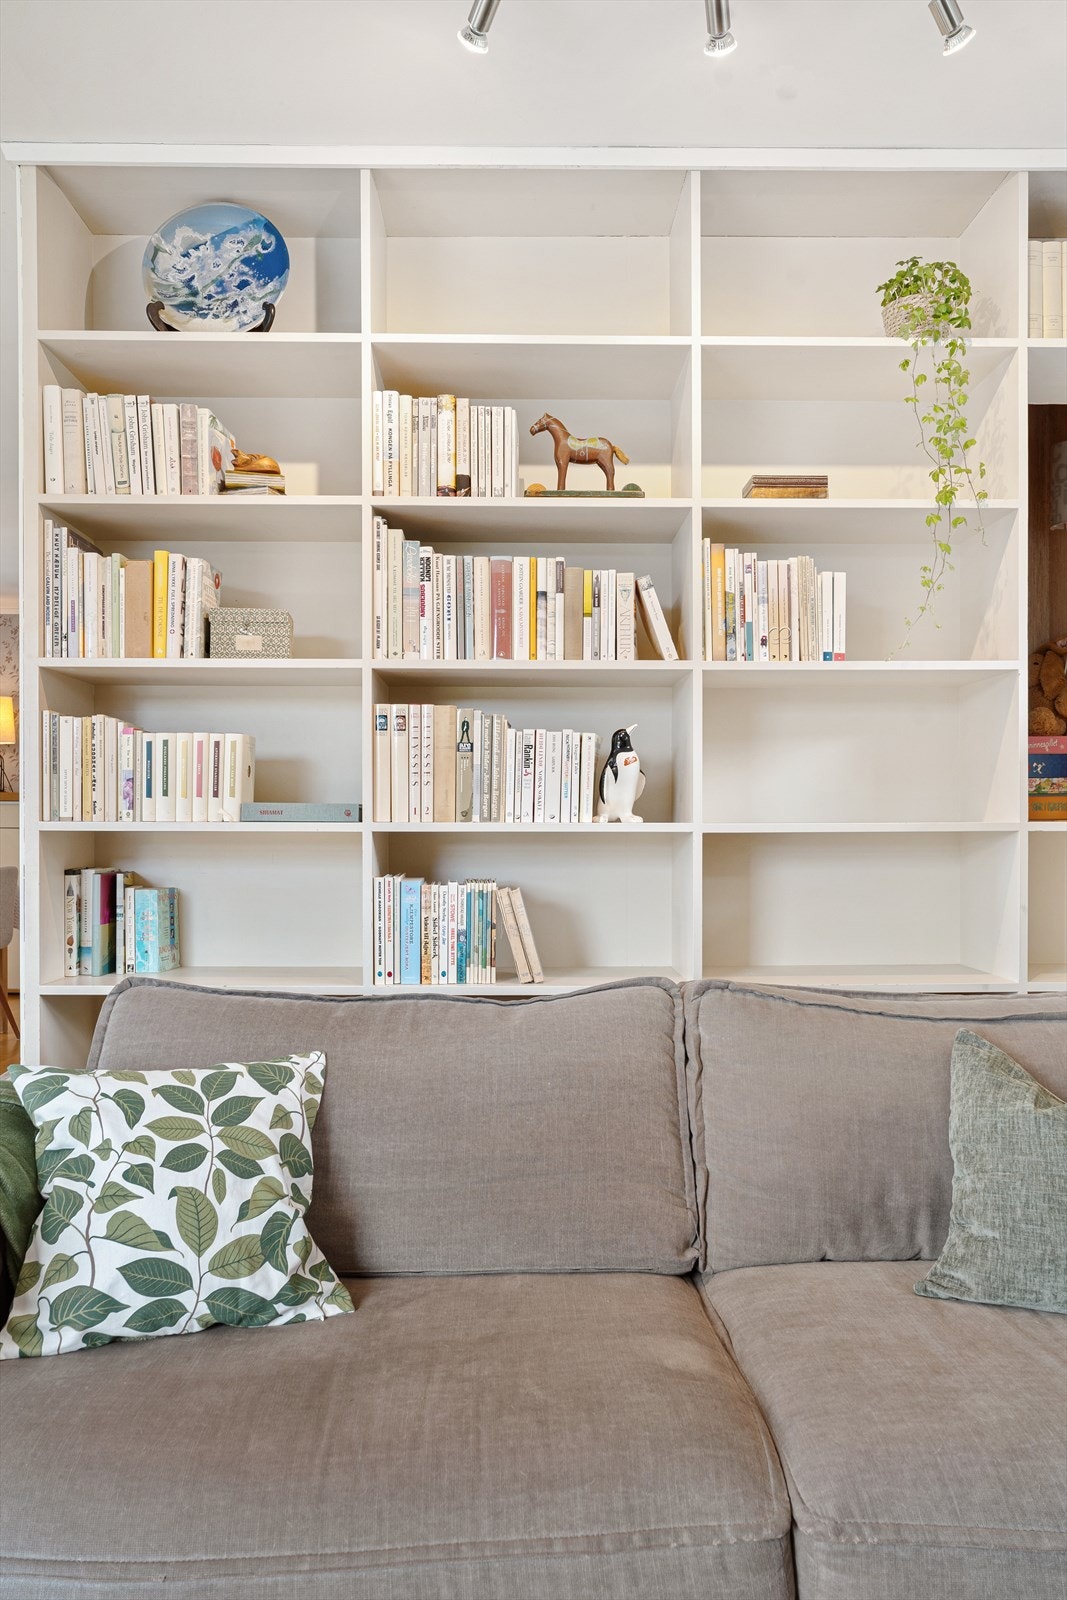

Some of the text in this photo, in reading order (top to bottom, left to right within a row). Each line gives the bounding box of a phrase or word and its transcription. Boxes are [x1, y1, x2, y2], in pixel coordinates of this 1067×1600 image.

[619, 608, 631, 655] ARTHUR
[524, 744, 533, 768] Rankin
[67, 897, 75, 935] NEW YORK
